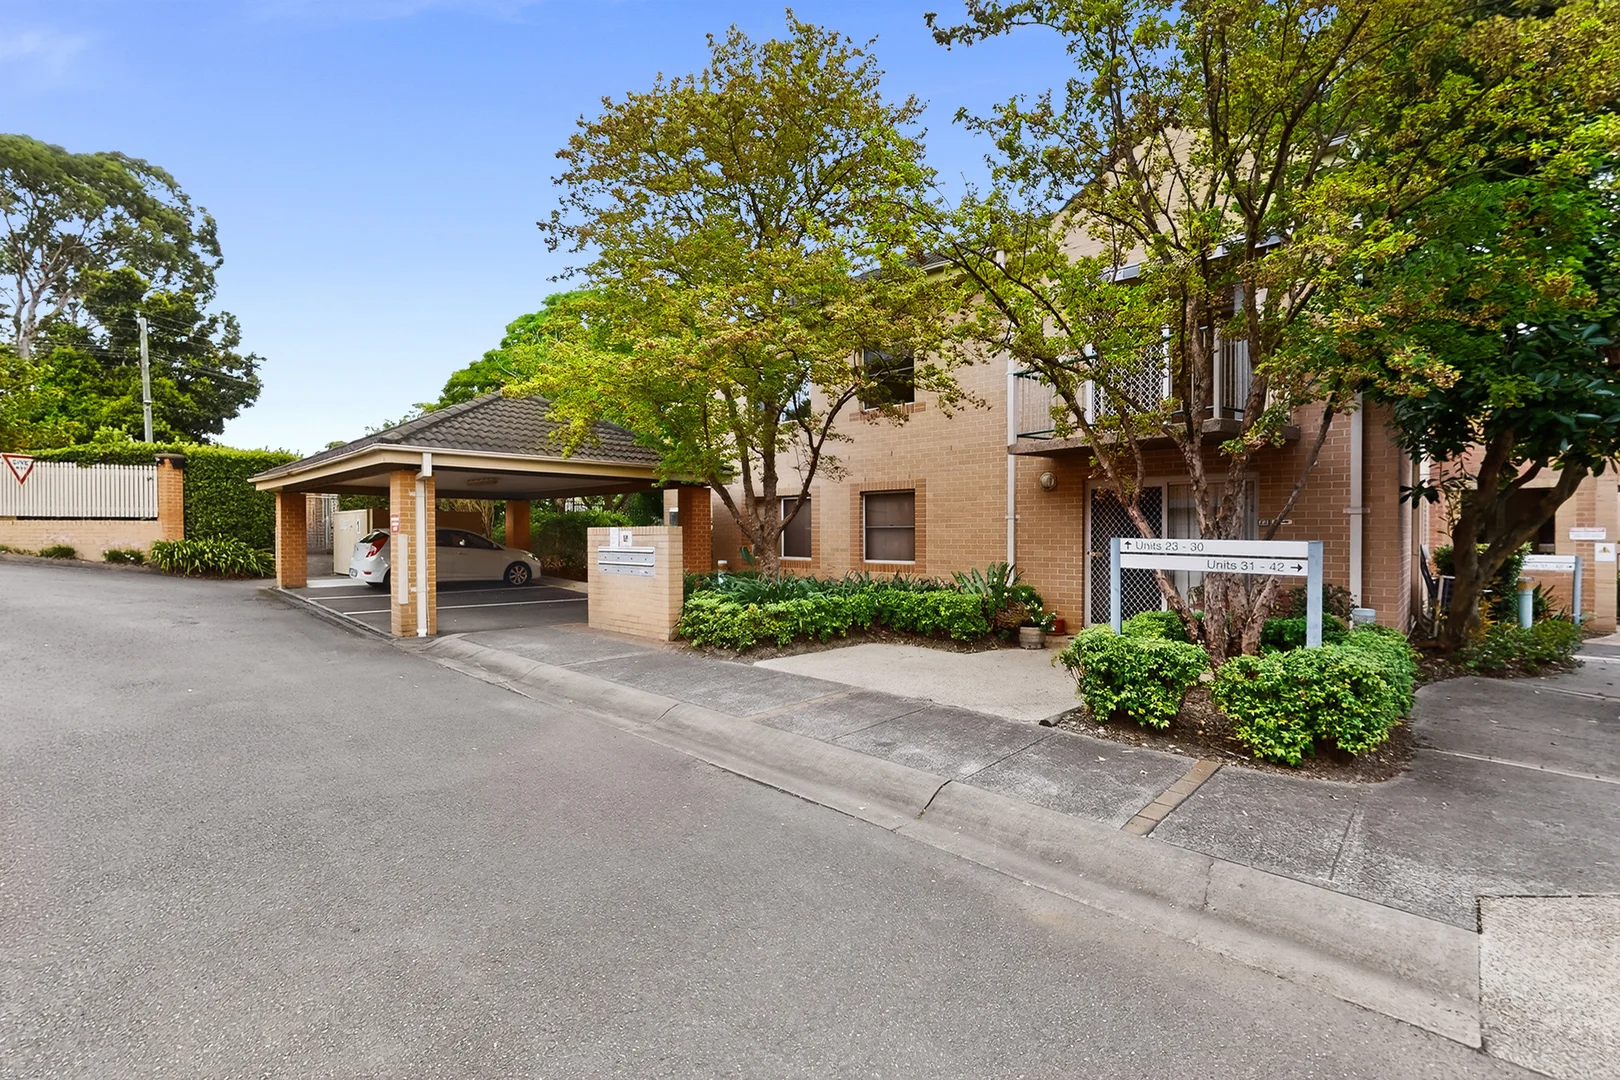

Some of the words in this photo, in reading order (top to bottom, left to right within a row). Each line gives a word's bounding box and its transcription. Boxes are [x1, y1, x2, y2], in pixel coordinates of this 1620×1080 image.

[1135, 541, 1162, 551] Units
[1165, 541, 1179, 551] 23
[1190, 542, 1204, 552] 30
[1206, 559, 1237, 570] Units
[1240, 560, 1254, 571] 31
[1269, 562, 1285, 572] 42
